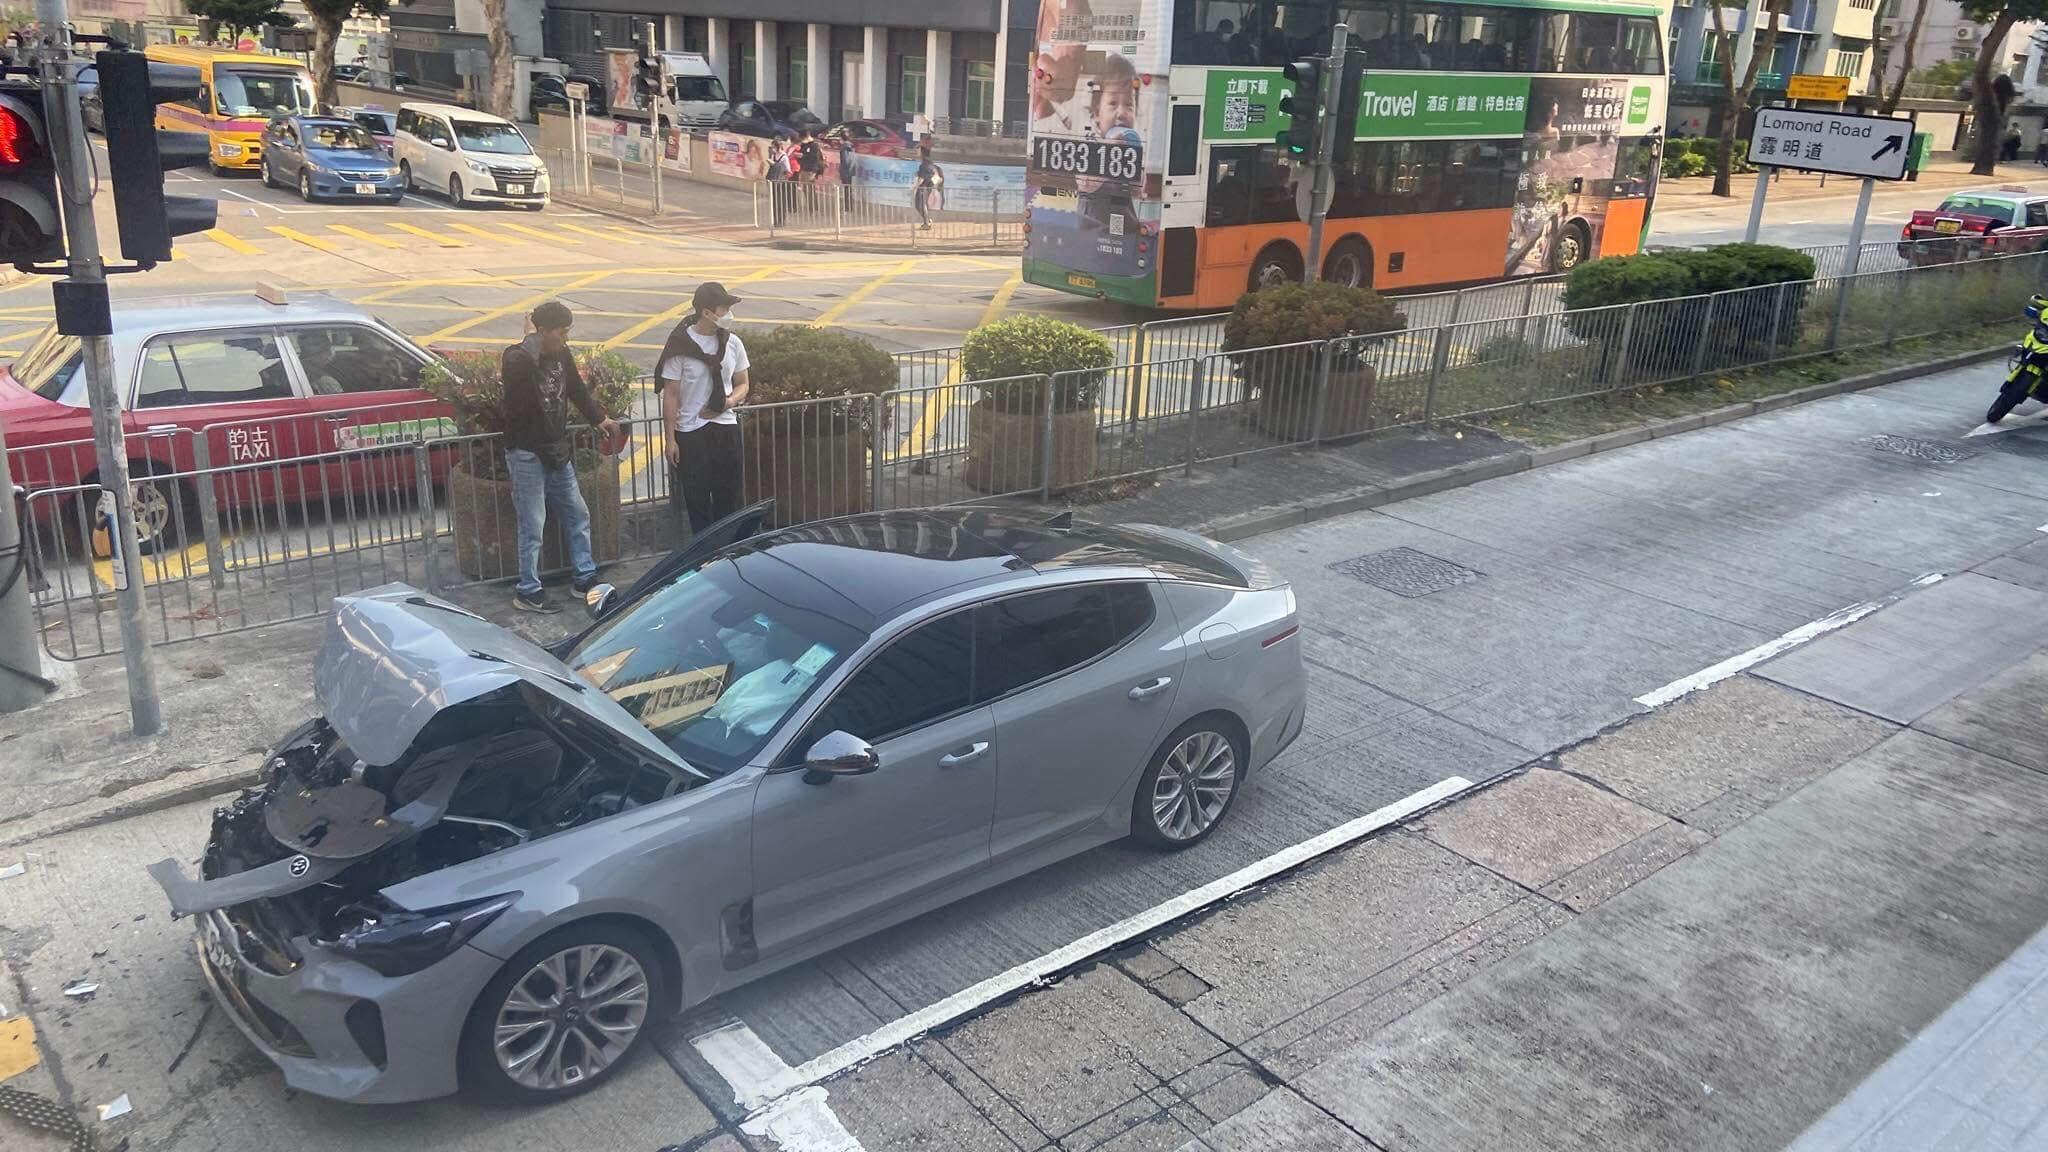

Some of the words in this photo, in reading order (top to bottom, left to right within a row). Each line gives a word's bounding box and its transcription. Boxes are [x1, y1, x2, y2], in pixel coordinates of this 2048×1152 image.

[1363, 90, 1418, 117] Travel
[1426, 95, 1449, 112] 酒店
[1762, 115, 1823, 133] Lomond
[1829, 120, 1872, 139] Road
[1039, 139, 1090, 173] 1833
[1097, 145, 1138, 179] 183
[1759, 135, 1824, 161] 露明道
[229, 426, 268, 444] 的士
[230, 442, 271, 461] TAXI
